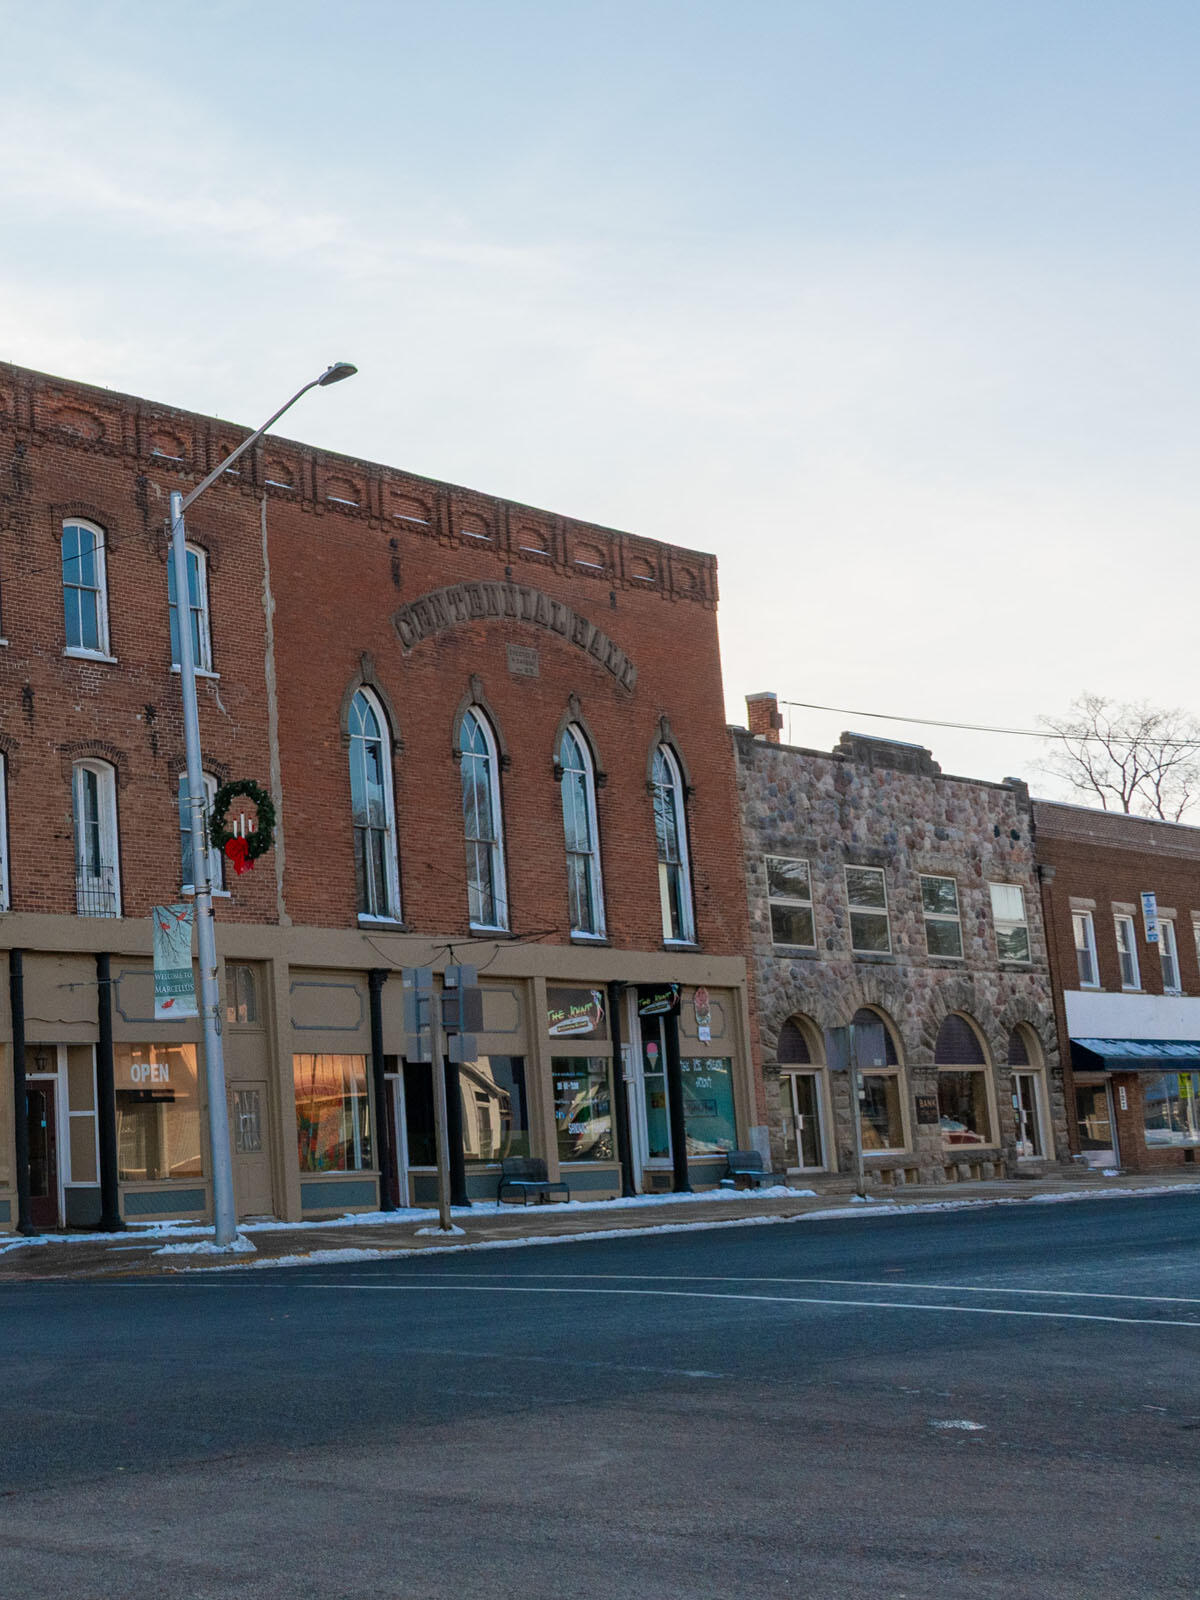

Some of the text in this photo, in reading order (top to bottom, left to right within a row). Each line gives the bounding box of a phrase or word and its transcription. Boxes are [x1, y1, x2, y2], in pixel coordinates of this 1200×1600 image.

[395, 584, 634, 693] CENTENNIAL HALL
[154, 983, 195, 993] MARCELLUS
[130, 1063, 169, 1082] OPEN
